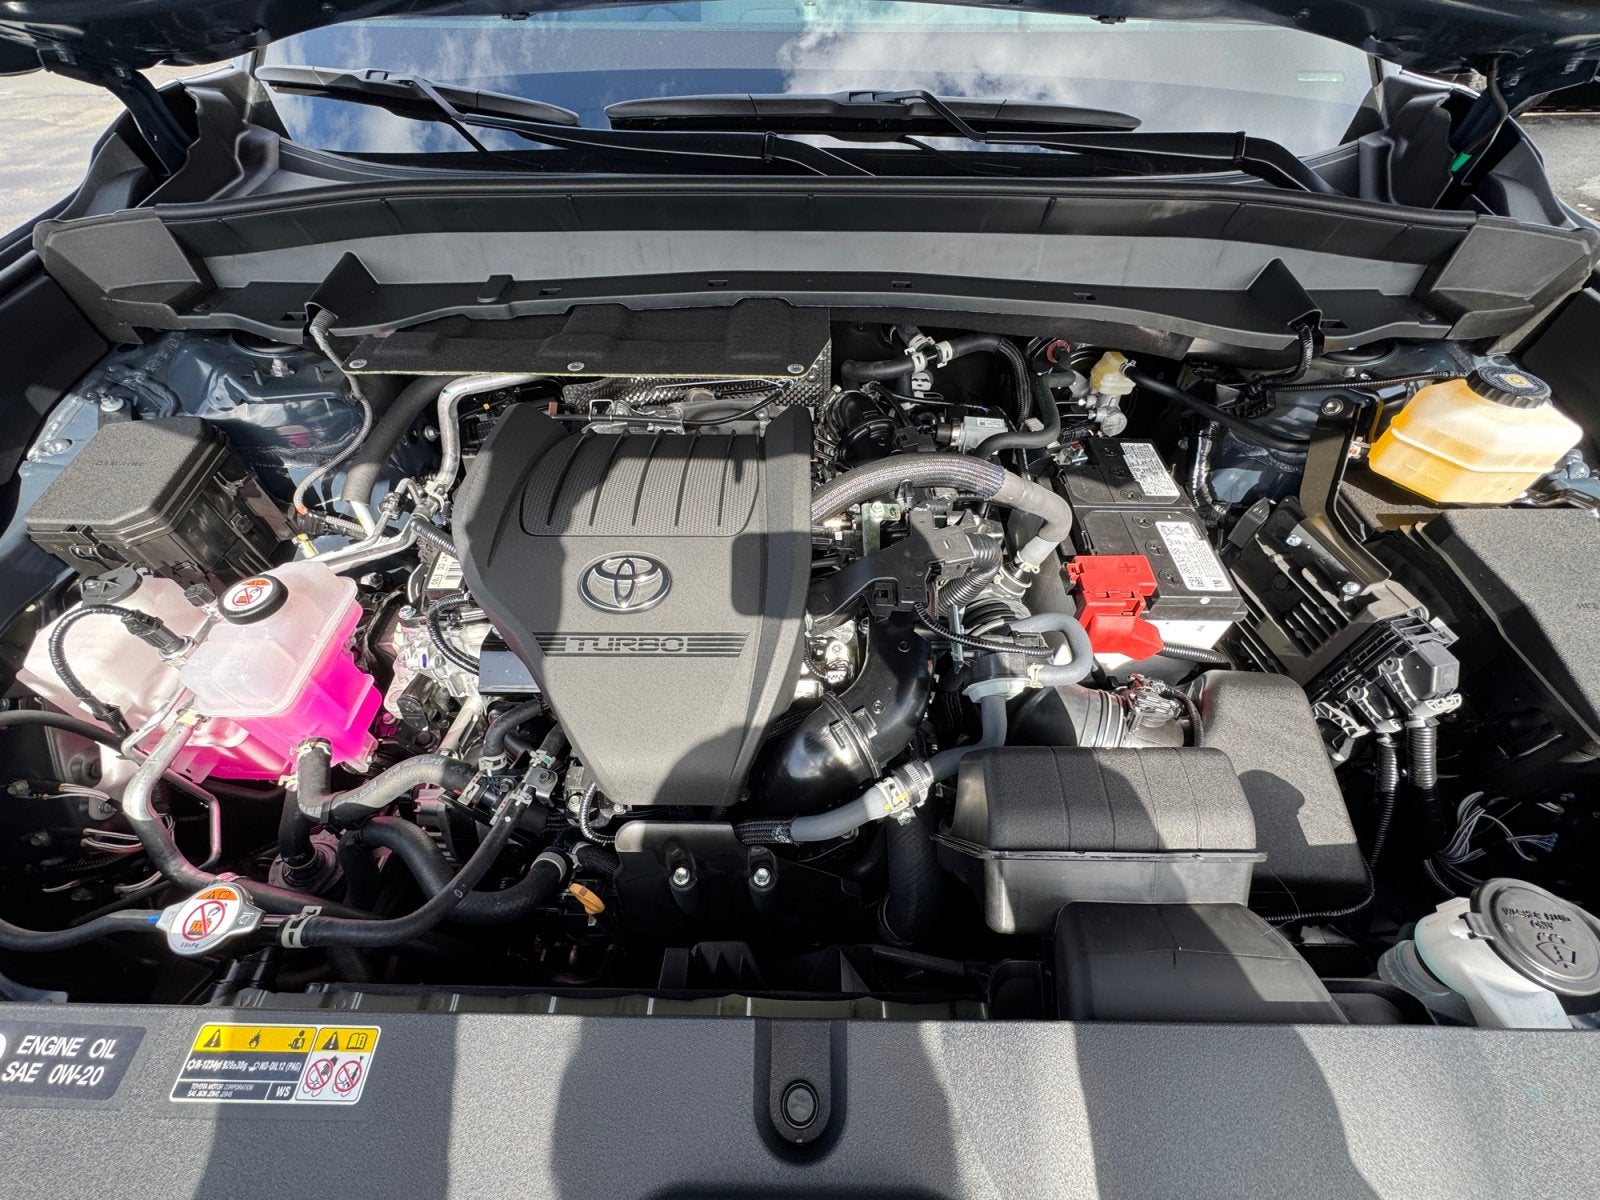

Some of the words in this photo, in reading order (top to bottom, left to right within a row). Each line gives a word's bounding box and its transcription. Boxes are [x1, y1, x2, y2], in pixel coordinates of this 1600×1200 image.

[570, 637, 685, 652] TURBO
[16, 1035, 86, 1057] ENGINE
[88, 1038, 118, 1059] OIL
[1, 1061, 45, 1083] SAE
[47, 1063, 105, 1087] 0W-20
[275, 1085, 292, 1097] WS
